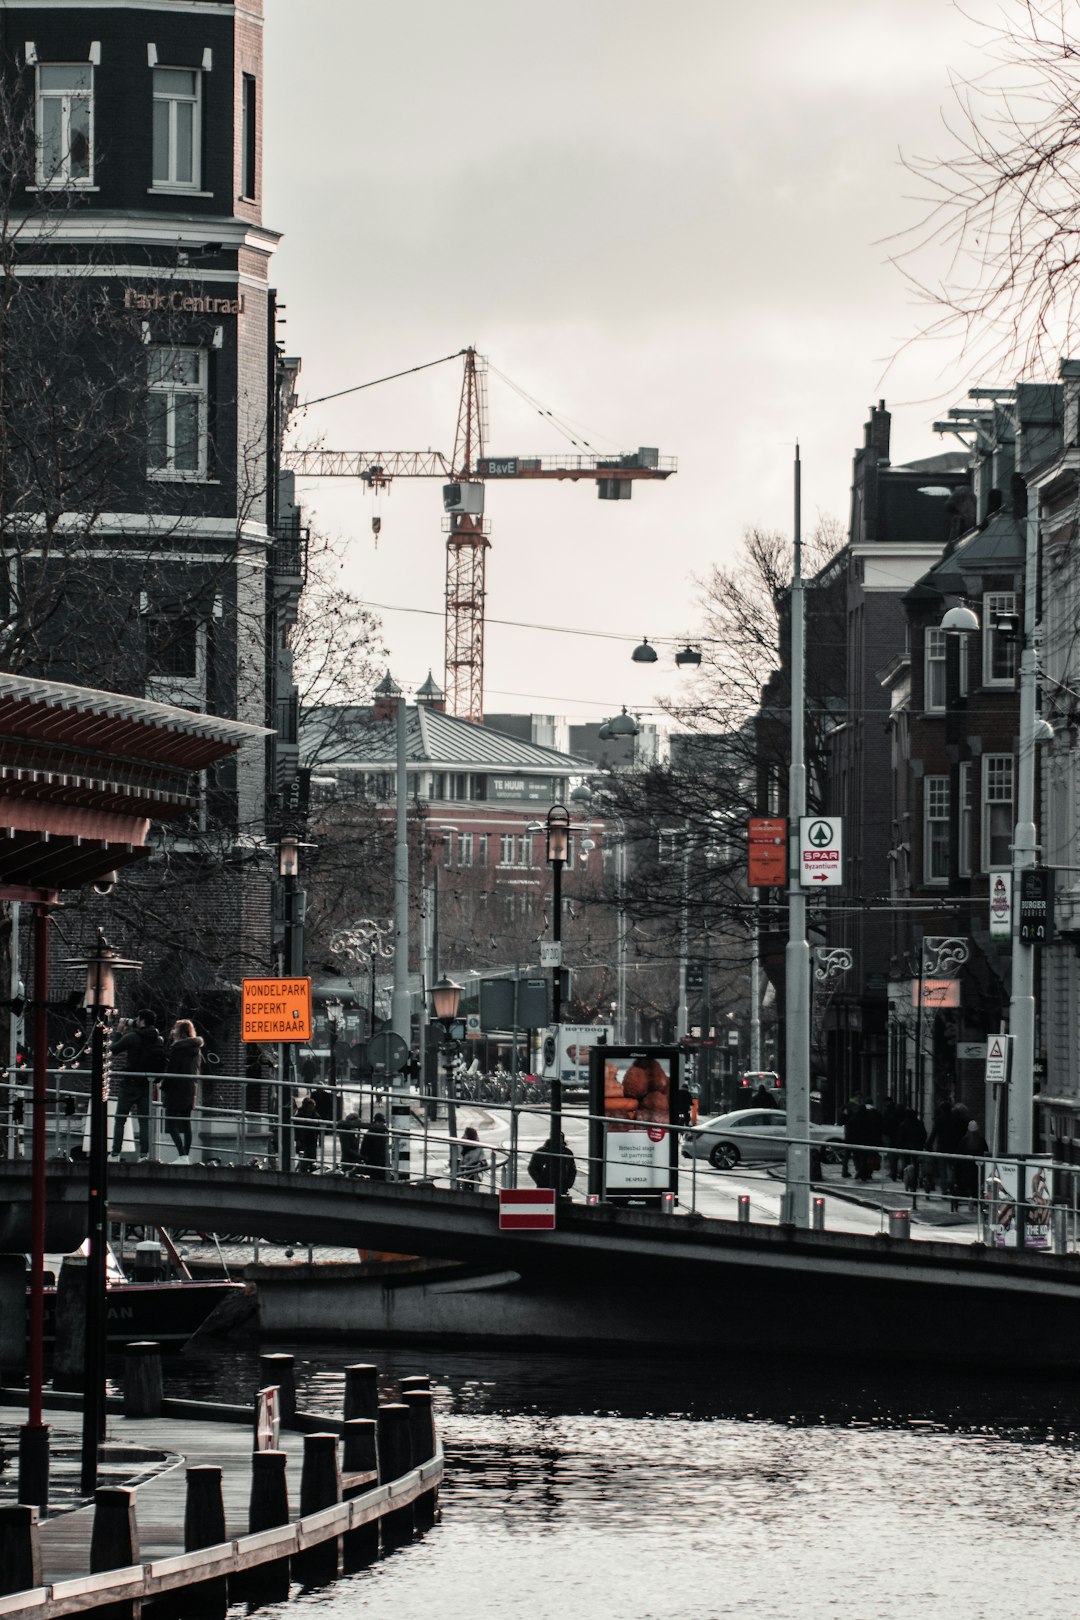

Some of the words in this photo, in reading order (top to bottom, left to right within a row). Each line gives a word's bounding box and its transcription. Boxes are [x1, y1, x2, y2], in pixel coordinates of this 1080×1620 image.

[124, 287, 166, 310] Park
[169, 290, 245, 314] Centraal
[494, 780, 503, 790] TE
[504, 780, 525, 790] HUUR
[804, 852, 838, 860] SPAR
[804, 863, 838, 871] Byzantium
[1021, 901, 1046, 909] BURGER
[245, 984, 306, 996] VONDELPARK
[245, 1002, 287, 1014] BEPERKT
[245, 1020, 304, 1032] BEREIKBAAR
[1026, 1225, 1039, 1235] THE
